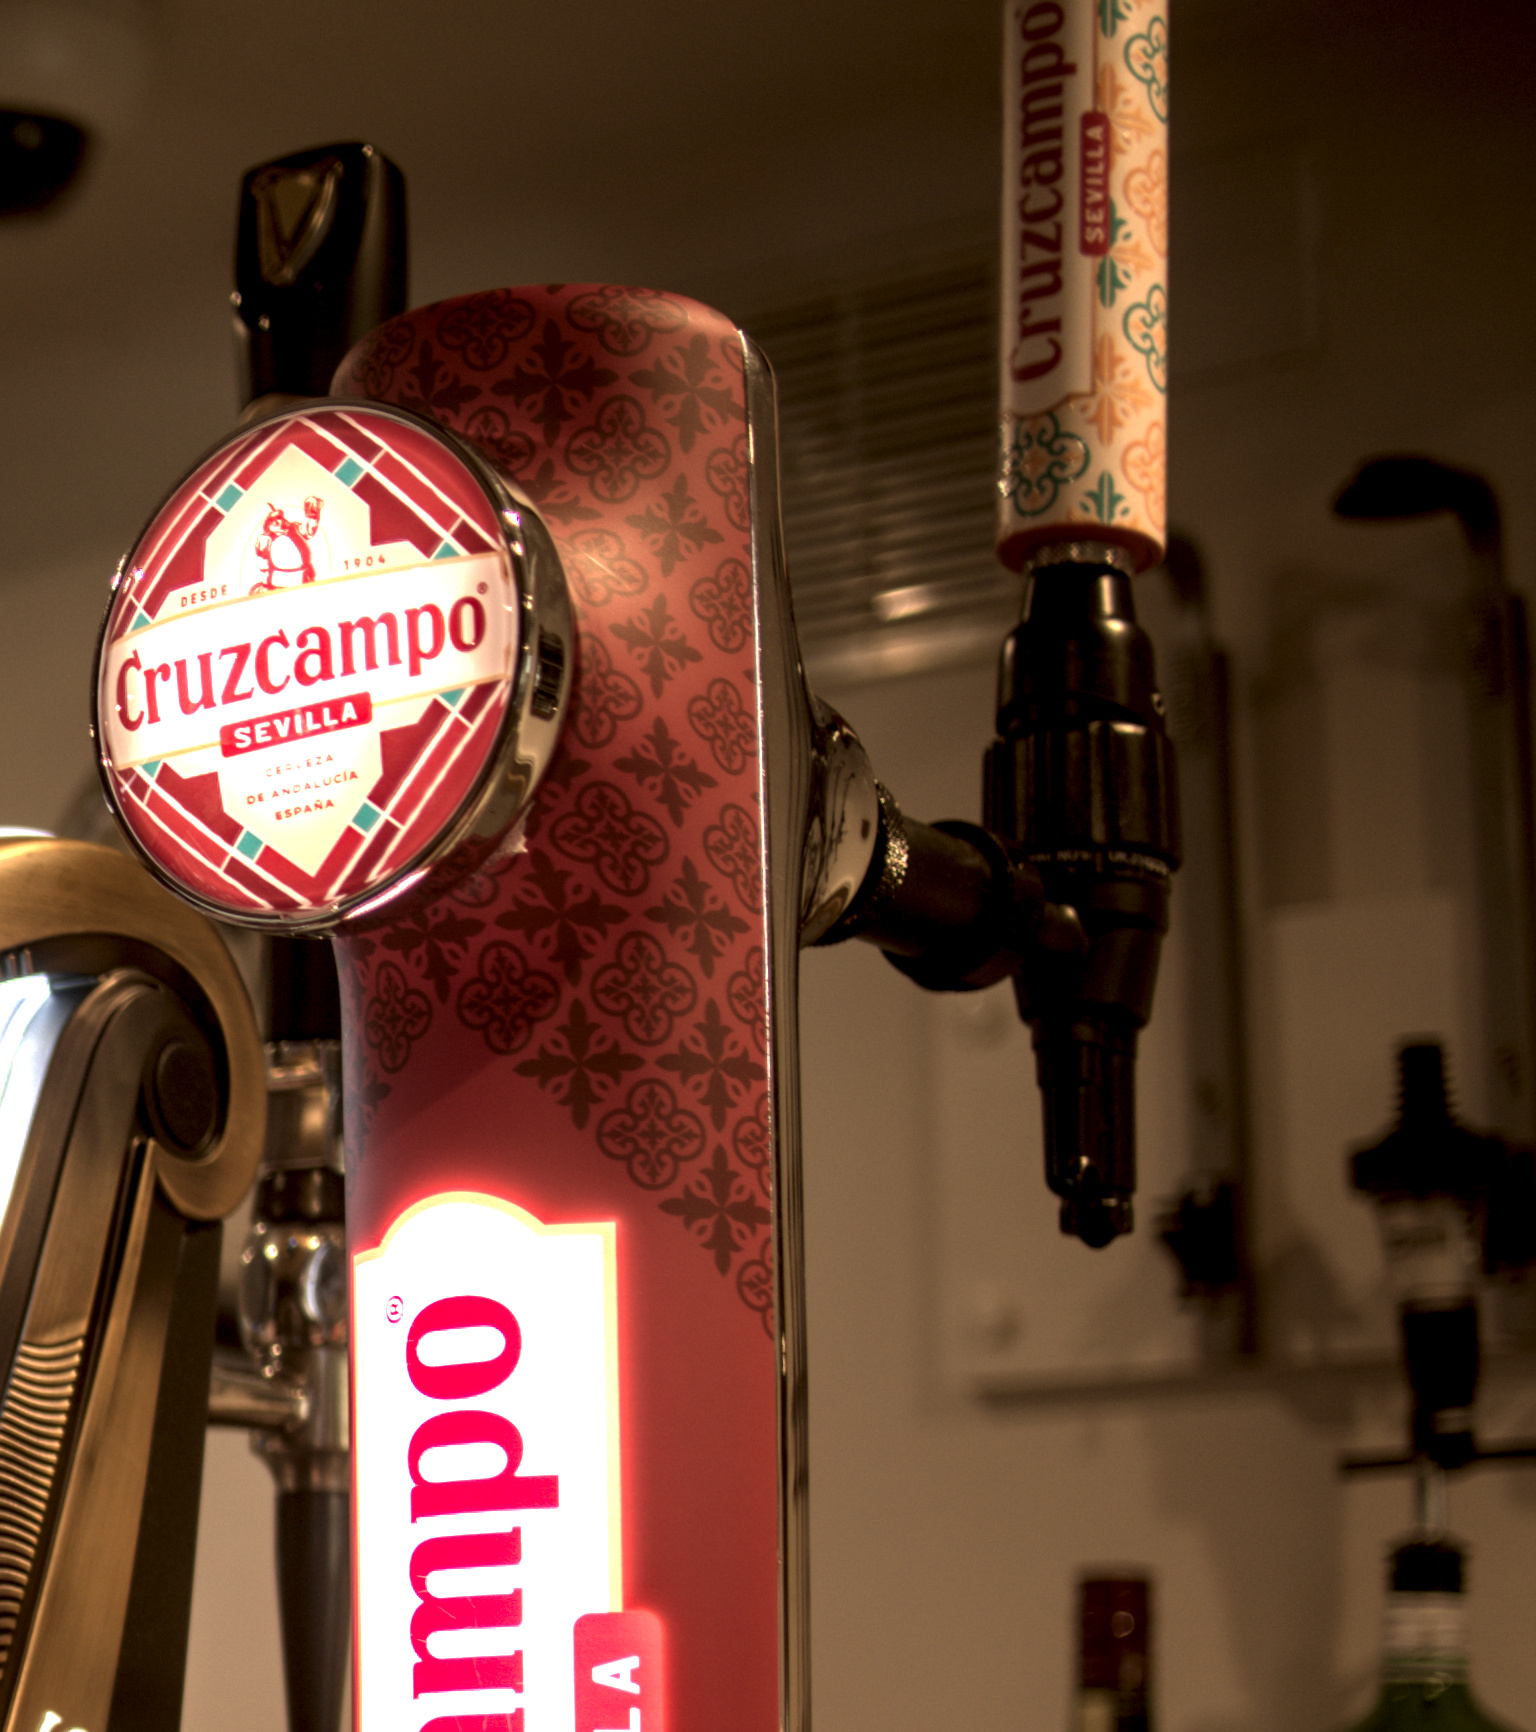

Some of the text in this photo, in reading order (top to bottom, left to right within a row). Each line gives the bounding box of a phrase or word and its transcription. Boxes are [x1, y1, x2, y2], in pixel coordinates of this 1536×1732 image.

[1009, 0, 1077, 384] Cruzcampo
[1085, 123, 1105, 243] SEVILLA
[180, 553, 388, 607] DESDE 1904
[115, 595, 486, 732] Cruzcampo
[233, 702, 360, 749] SEVILLA
[246, 769, 359, 806] DE ANDALUCÍA
[265, 753, 334, 777] CERVEZA
[274, 798, 335, 821] ESPAÑA
